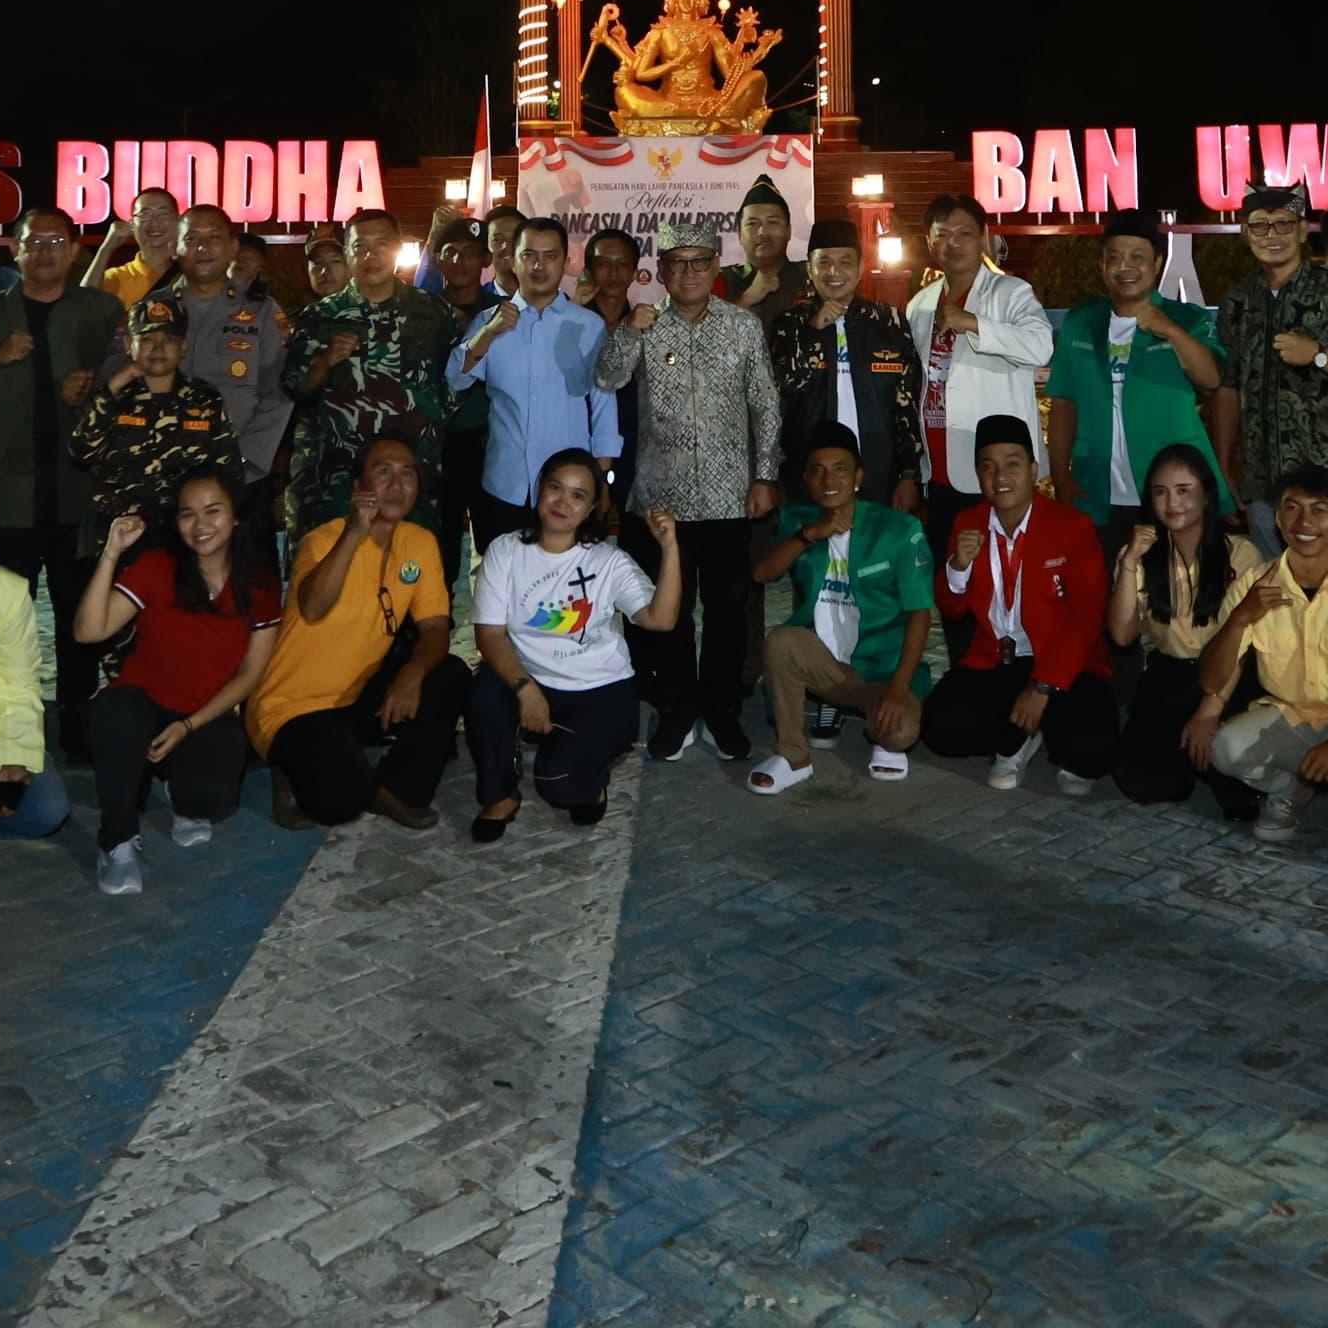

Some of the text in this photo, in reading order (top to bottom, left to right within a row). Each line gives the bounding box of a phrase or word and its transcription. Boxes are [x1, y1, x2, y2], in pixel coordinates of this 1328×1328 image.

[57, 140, 386, 225] BUDDHA
[591, 183, 629, 192] PERINGATAN
[631, 183, 647, 191] HARI
[648, 183, 667, 191] LAHIR
[668, 183, 703, 191] PANCASILA
[710, 182, 723, 190] JUNI
[725, 182, 740, 190] 1945
[223, 325, 259, 336] POLRI
